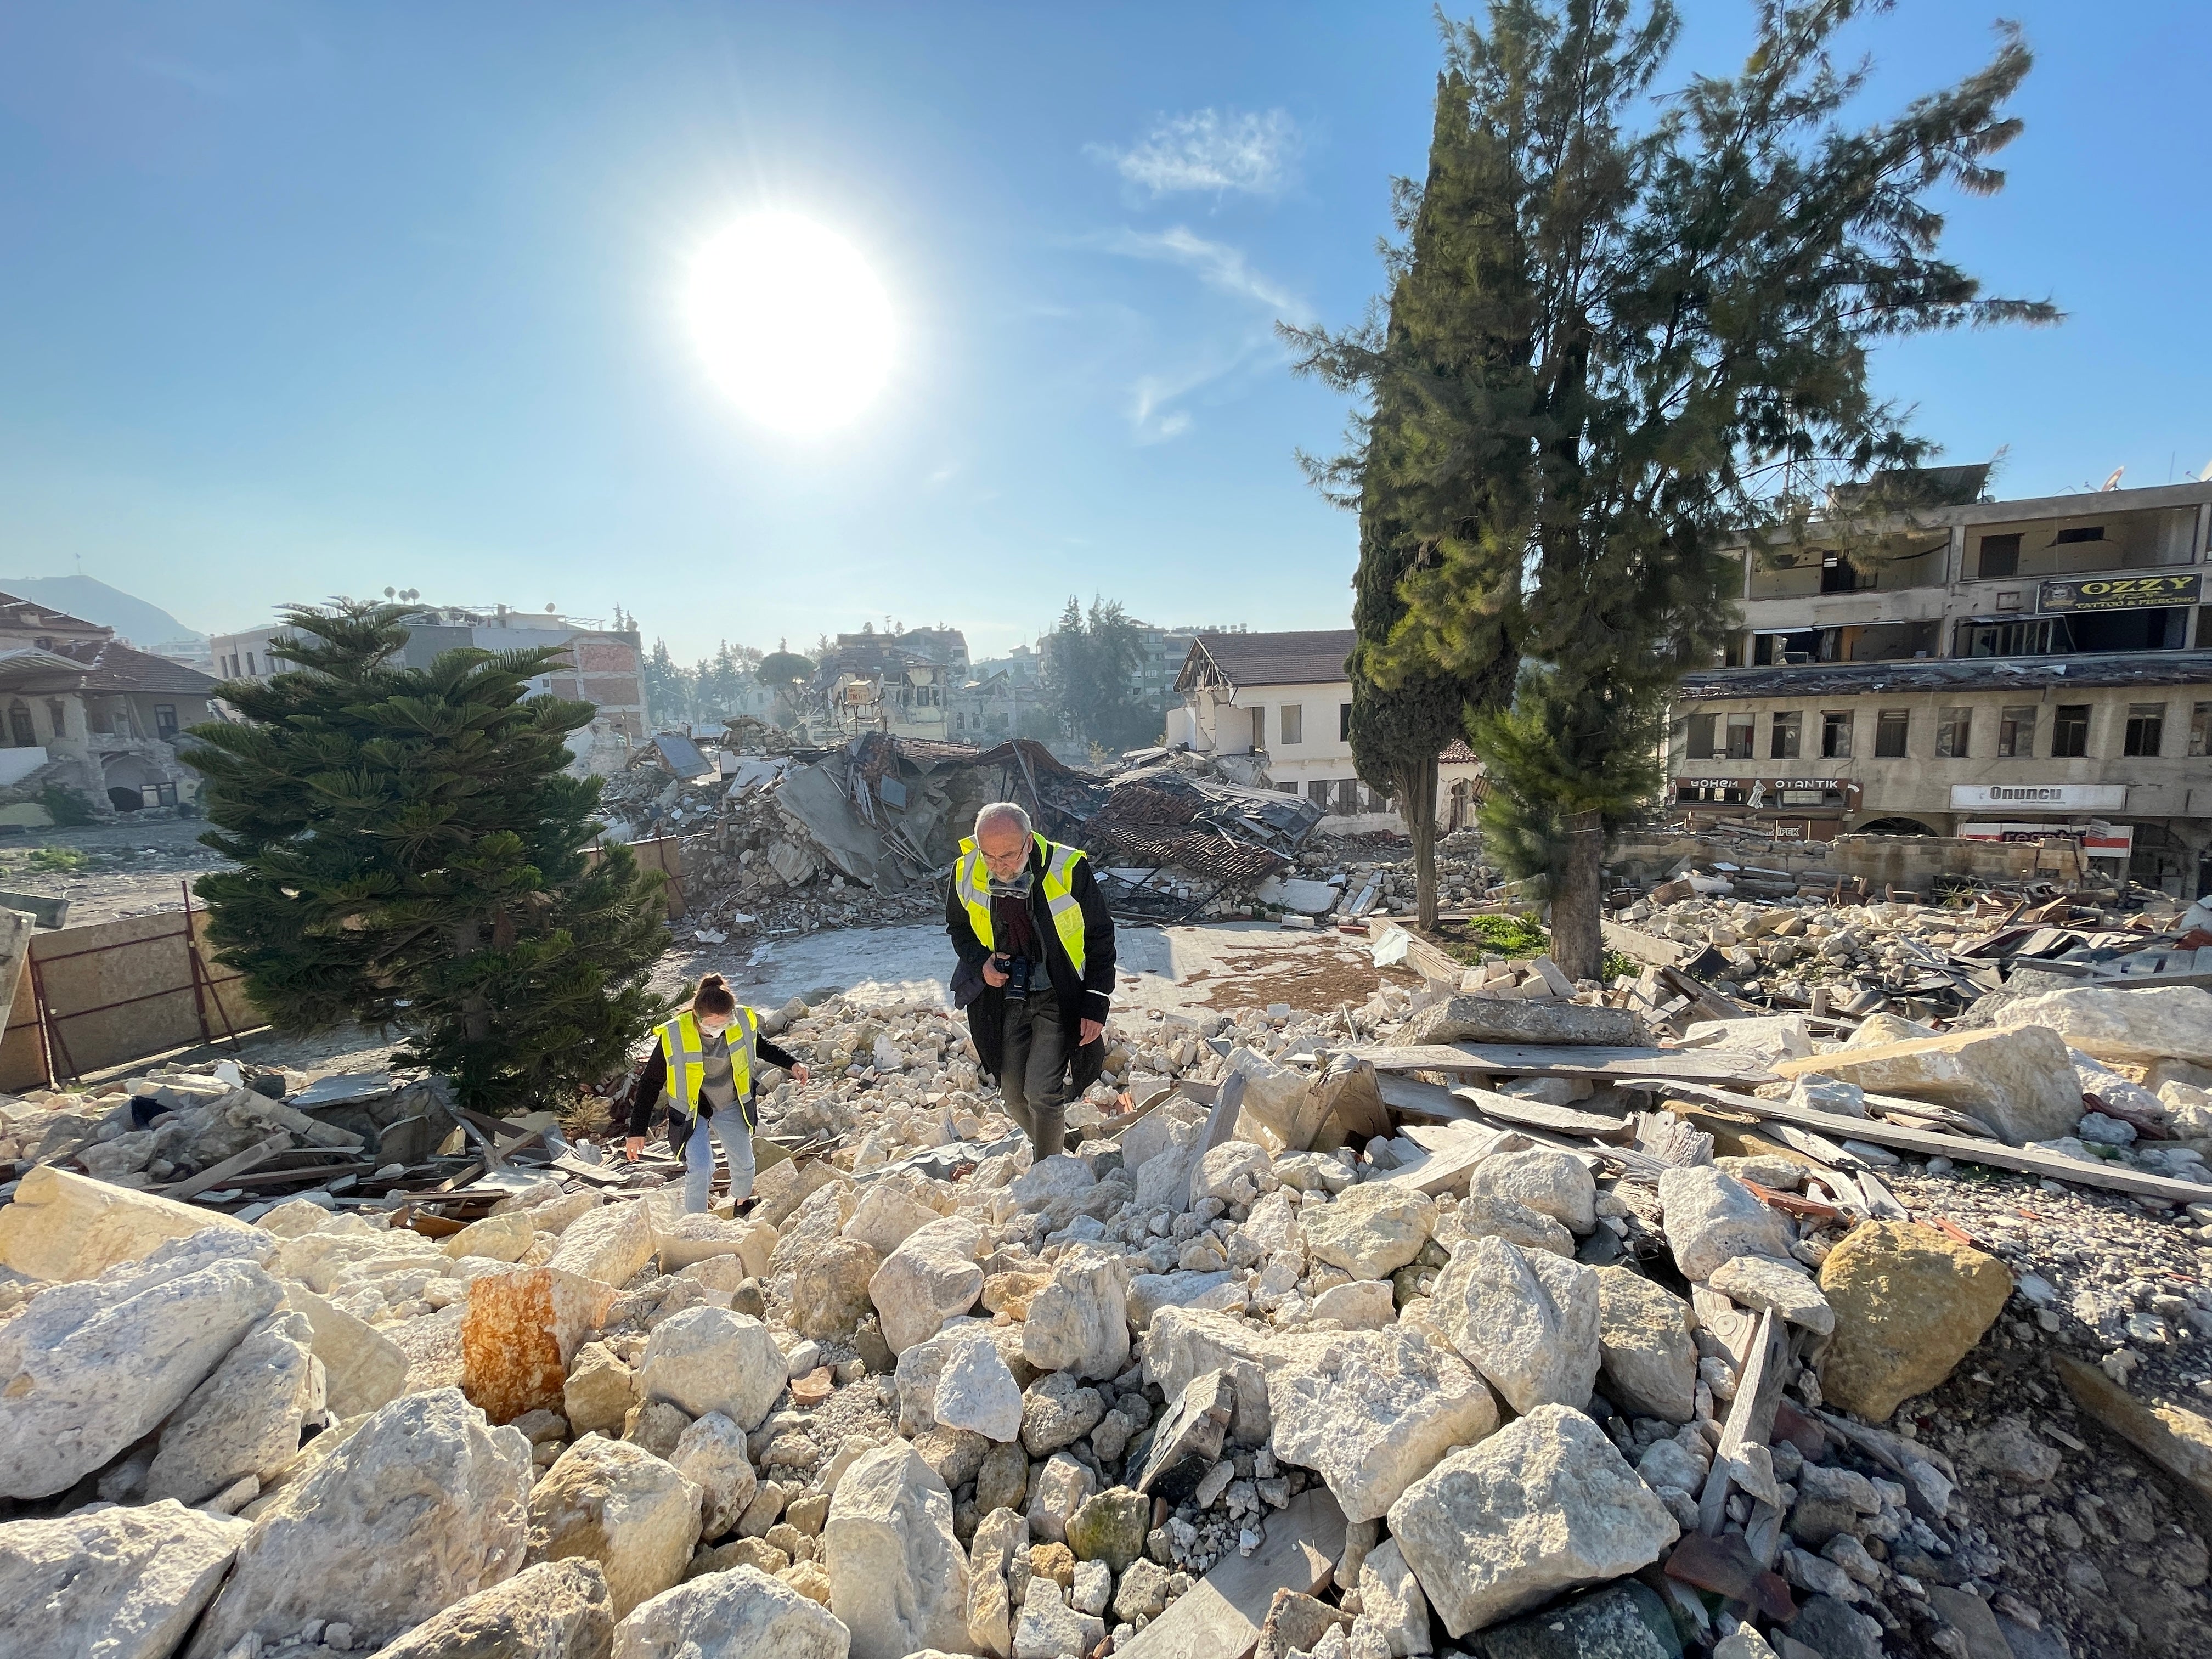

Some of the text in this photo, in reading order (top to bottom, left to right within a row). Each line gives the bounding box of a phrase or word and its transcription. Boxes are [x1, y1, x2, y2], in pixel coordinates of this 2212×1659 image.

[2081, 577, 2193, 595] OZZY
[2140, 596, 2196, 605] PIERCING
[1775, 780, 1838, 788] OTANTIK
[1990, 786, 2062, 800] Onuncu
